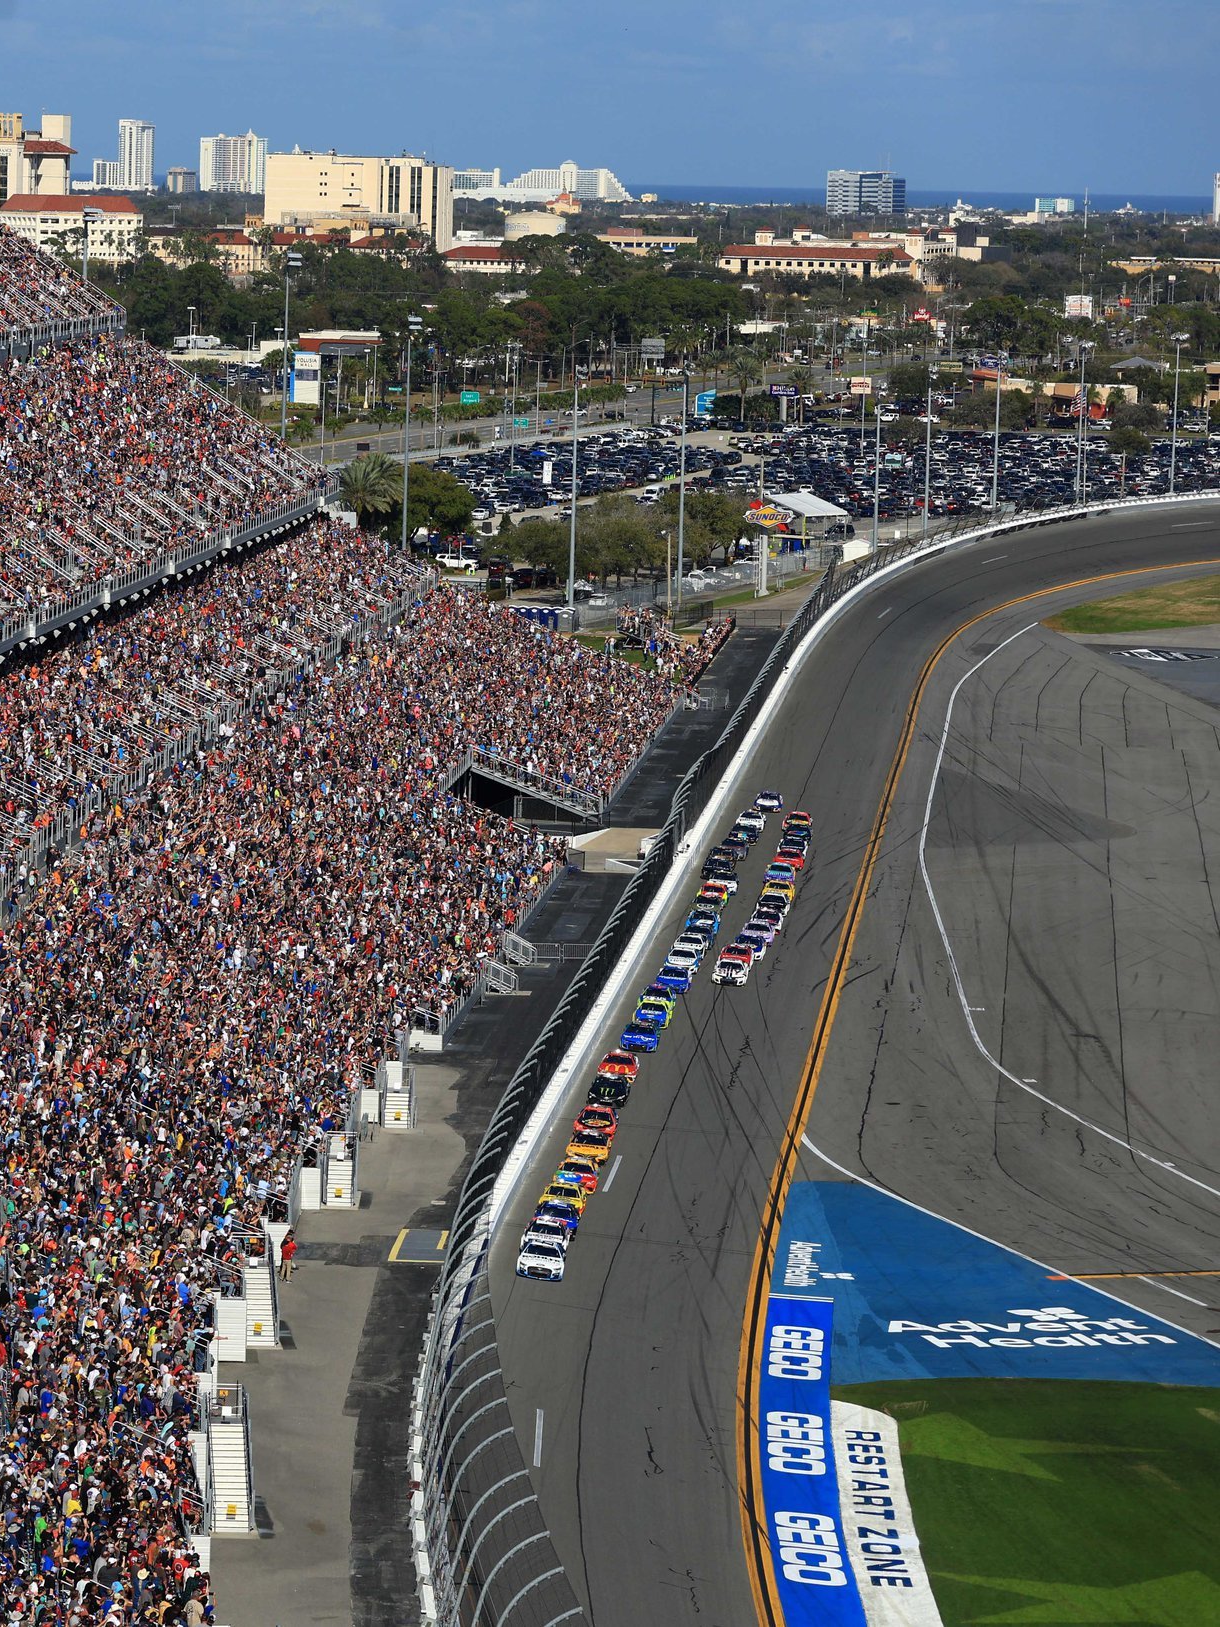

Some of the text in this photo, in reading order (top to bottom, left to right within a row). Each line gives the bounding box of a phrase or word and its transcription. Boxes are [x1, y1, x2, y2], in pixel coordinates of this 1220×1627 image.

[749, 513, 788, 521] SUNOCO
[768, 1325, 825, 1381] GEICO
[887, 1317, 1149, 1333] Advent
[920, 1331, 1178, 1348] Health
[766, 1411, 826, 1476] GEICO
[845, 1430, 914, 1588] RESTART ZONE
[774, 1511, 848, 1587] GEICO
